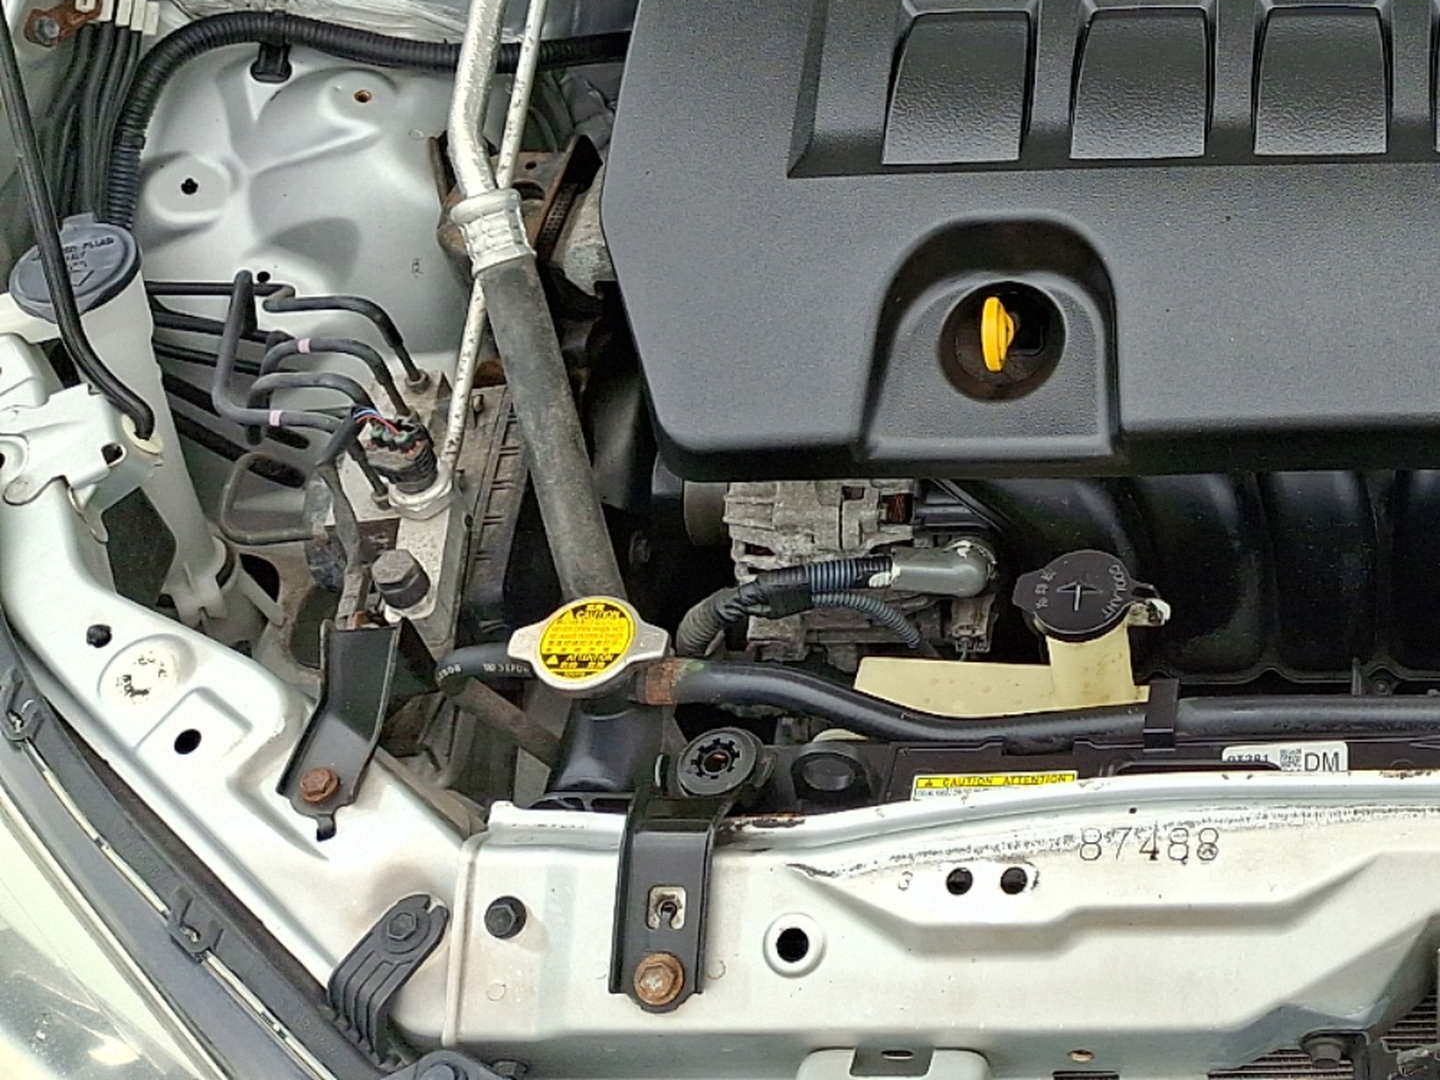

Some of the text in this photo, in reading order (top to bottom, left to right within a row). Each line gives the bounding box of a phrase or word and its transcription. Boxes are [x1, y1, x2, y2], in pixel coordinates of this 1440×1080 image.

[576, 610, 620, 620] CAUTION
[1304, 752, 1340, 772] DM
[943, 773, 1066, 788] CAUTION ATTENTION
